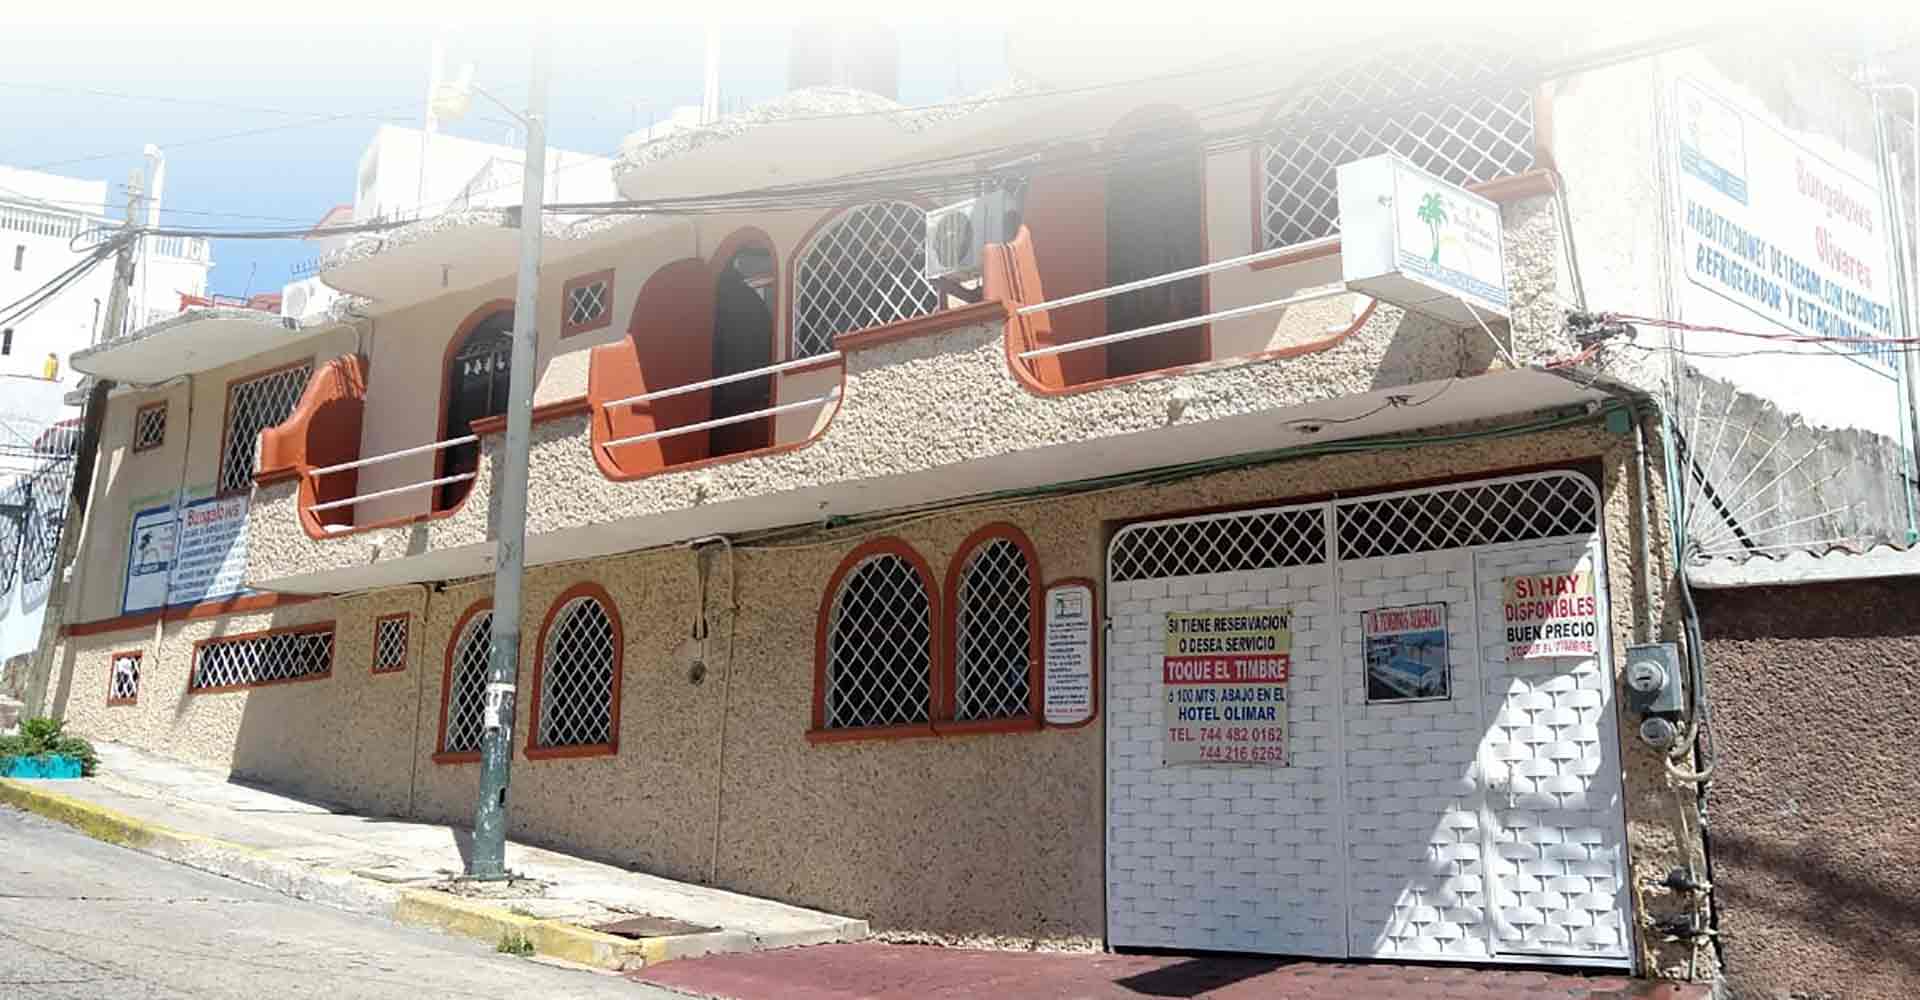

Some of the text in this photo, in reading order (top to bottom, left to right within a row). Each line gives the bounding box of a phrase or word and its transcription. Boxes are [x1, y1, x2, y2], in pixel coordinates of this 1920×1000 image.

[1687, 200, 1766, 271] HABITACIONES
[1697, 242, 1782, 313] REFRIGERADOR
[1784, 287, 1794, 322] Y
[1516, 575, 1579, 598] SI HAY
[1505, 597, 1595, 622] DISPONIBLES
[1168, 618, 1178, 633] SI
[1181, 617, 1211, 633] TIENE
[1507, 621, 1595, 642] BUEN PRECIO
[1179, 636, 1275, 653] O DESEA SERVICIO
[1167, 659, 1286, 681] TOQUE EL TIMBRE
[1177, 688, 1194, 703] 100
[1221, 688, 1254, 702] ABAJO
[1257, 687, 1271, 702] EN
[1273, 687, 1285, 702] EL
[1178, 706, 1276, 721] HOTEL OLIMAR
[1169, 728, 1195, 743] TEL.
[1200, 728, 1223, 742] 744
[1199, 746, 1223, 761] 744
[1225, 746, 1249, 761] 216
